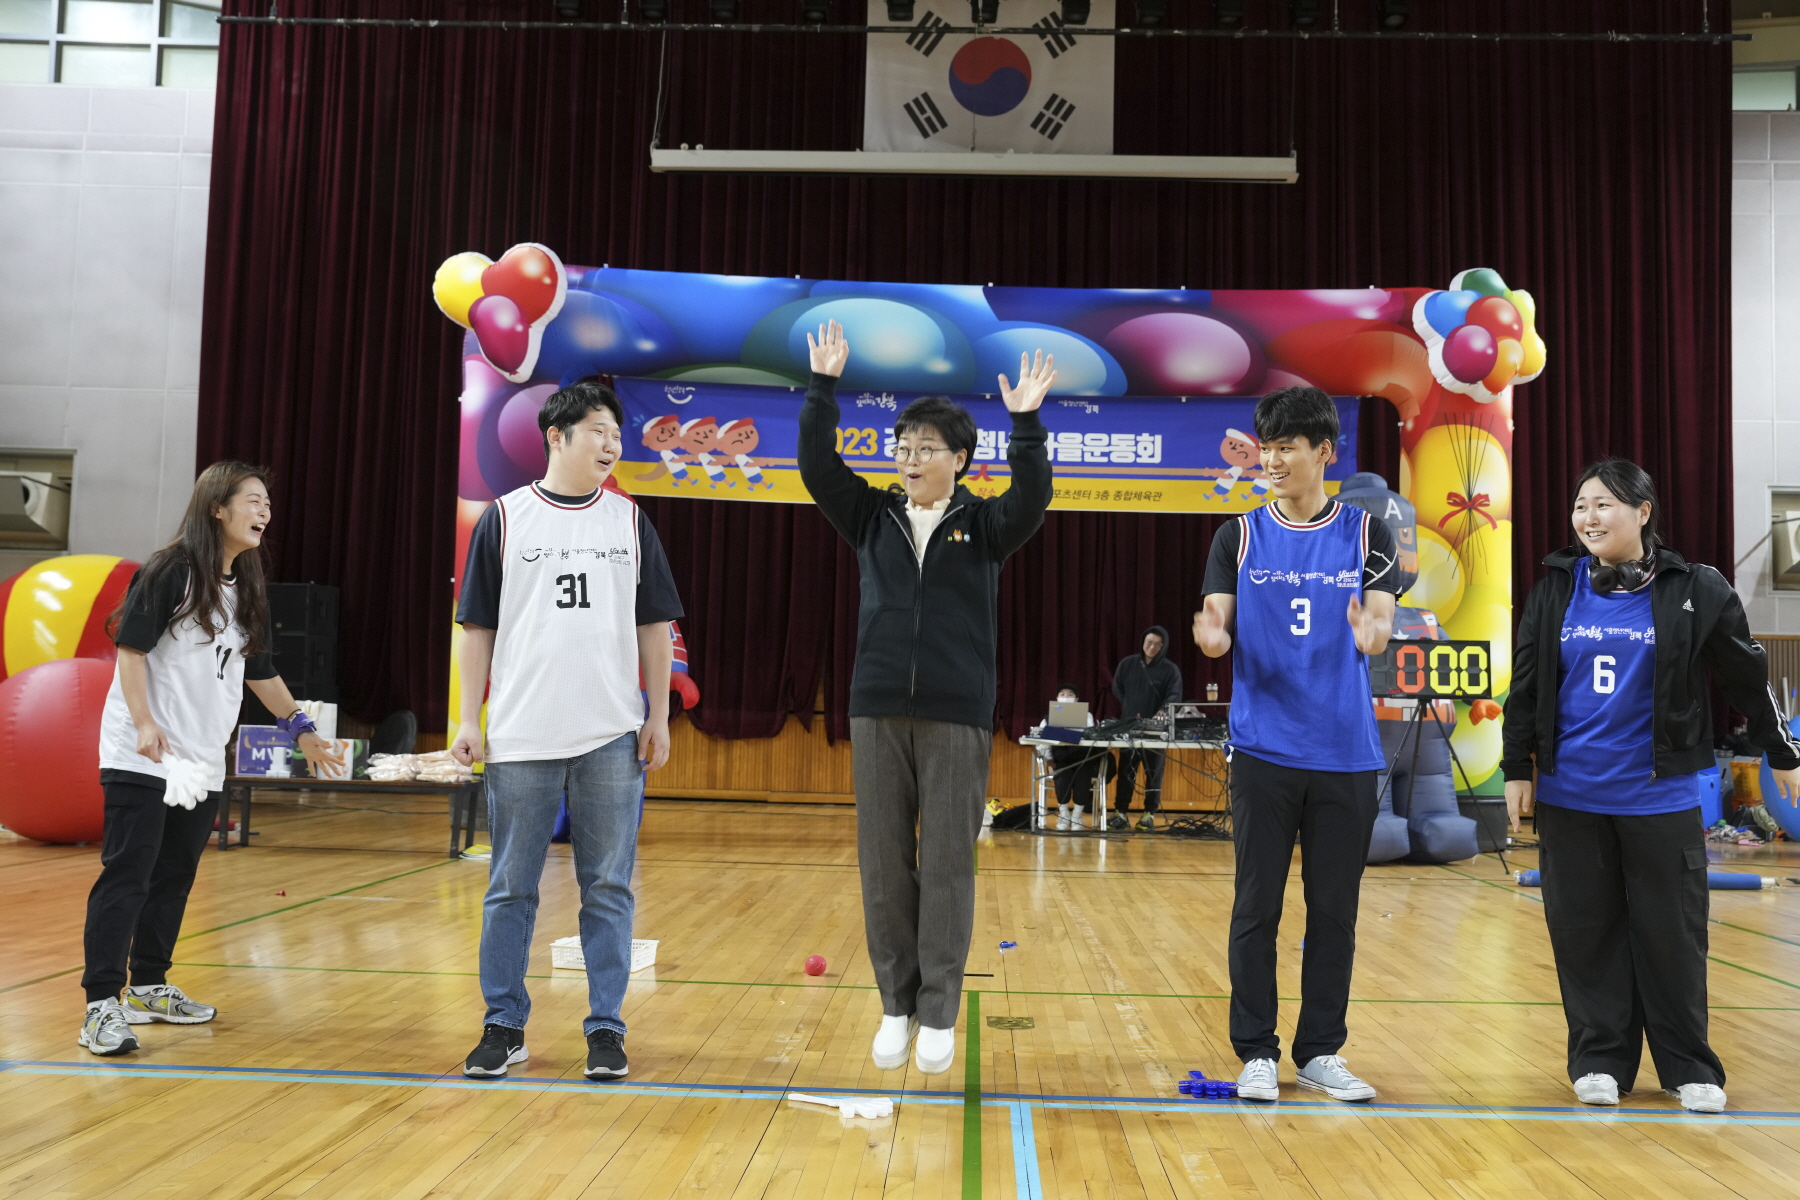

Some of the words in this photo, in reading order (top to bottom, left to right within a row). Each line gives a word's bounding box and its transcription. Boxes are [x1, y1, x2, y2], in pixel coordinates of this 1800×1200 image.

[835, 427, 878, 456] 23
[973, 428, 1009, 460] 청
[1053, 489, 1092, 500] 포츠센터
[1094, 490, 1110, 501] 3층
[1113, 490, 1162, 502] 종합체육관
[1384, 498, 1403, 521] A
[556, 573, 591, 609] 31
[1290, 597, 1311, 636] 3
[215, 644, 233, 680] 11
[1593, 655, 1617, 694] 6
